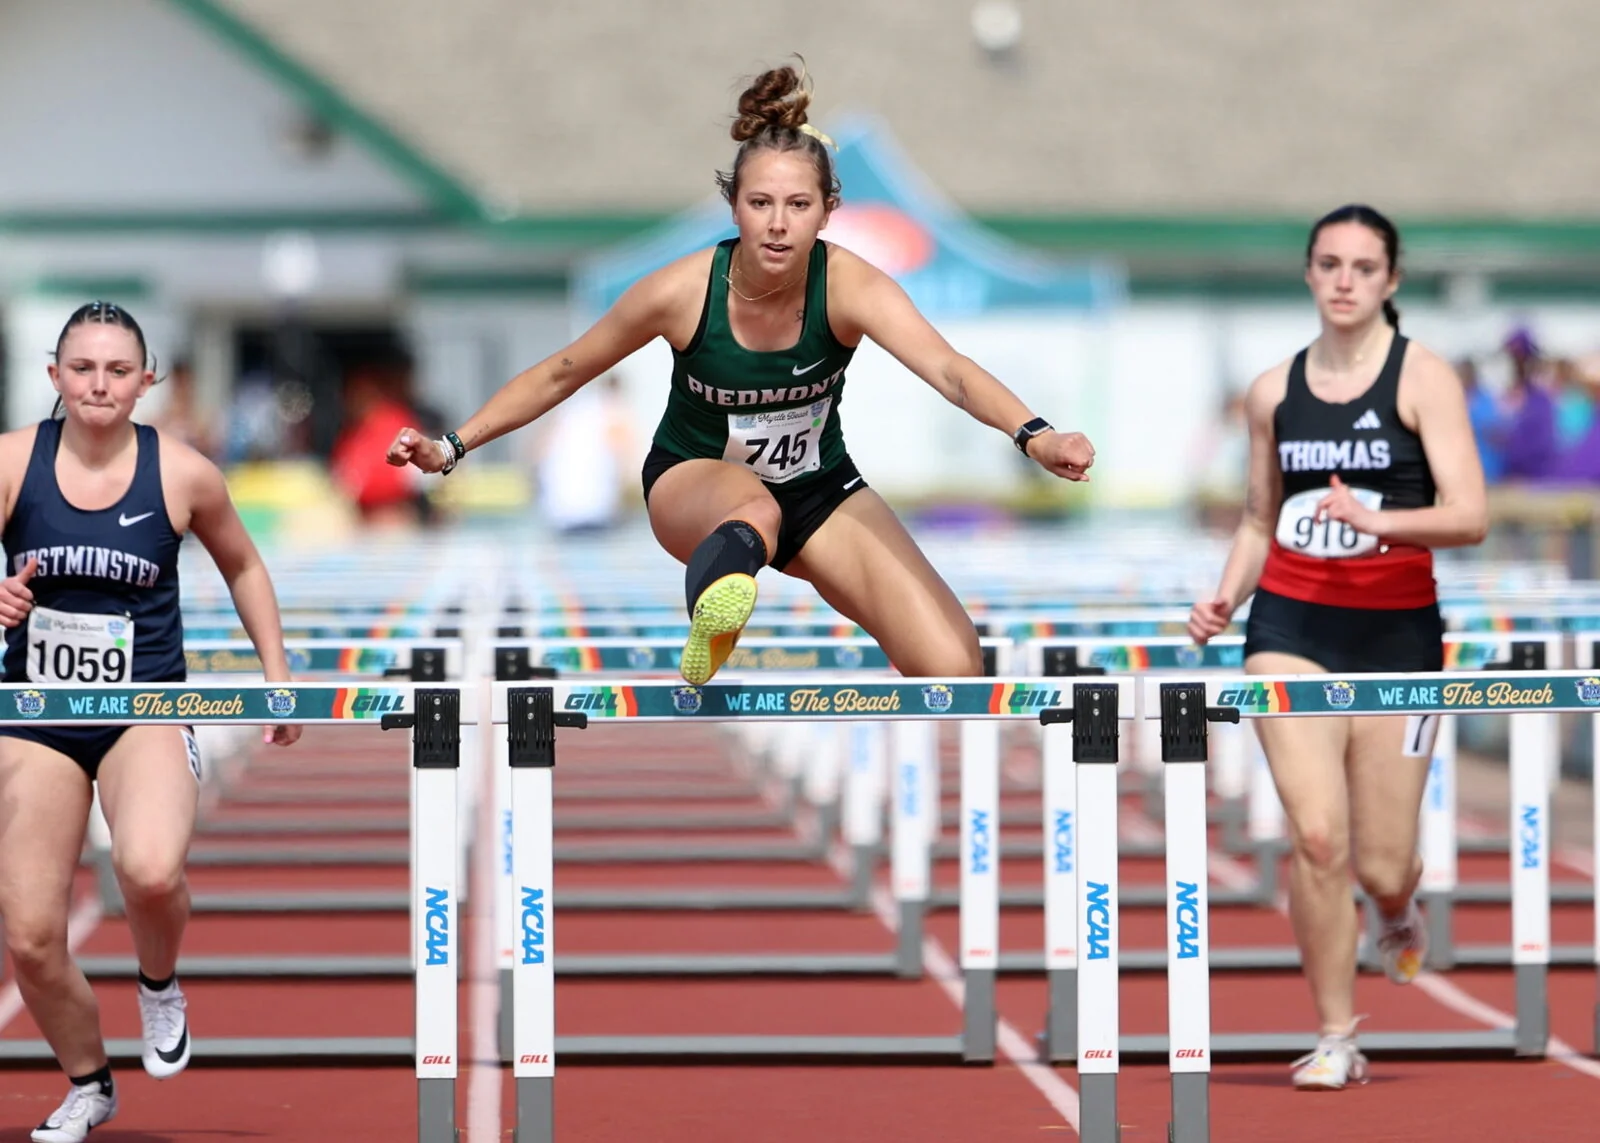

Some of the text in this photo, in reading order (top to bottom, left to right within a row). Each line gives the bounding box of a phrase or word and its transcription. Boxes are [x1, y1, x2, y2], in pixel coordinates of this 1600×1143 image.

[687, 366, 844, 407] PIEDMONT
[745, 429, 811, 471] 745
[1279, 440, 1391, 471] THOMAS
[33, 640, 127, 683] 1059
[68, 692, 244, 716] WE ARE The Beach
[351, 695, 405, 711] GILL
[564, 693, 621, 710] GILL
[725, 688, 901, 713] WE ARE The Beach
[1008, 690, 1063, 706] GILL
[1217, 689, 1271, 706] GILL
[1377, 681, 1554, 707] WE ARE The Beach
[970, 808, 990, 875] NCAA
[1054, 808, 1073, 874] NCAA
[425, 886, 449, 966] NCAA
[521, 886, 545, 965] NCAA
[1087, 881, 1110, 961] NCAA
[1176, 880, 1200, 960] NCAA
[422, 1055, 452, 1065] GILL
[520, 1054, 549, 1064] GILL
[1084, 1048, 1114, 1059] GILL
[1175, 1048, 1205, 1059] GILL
